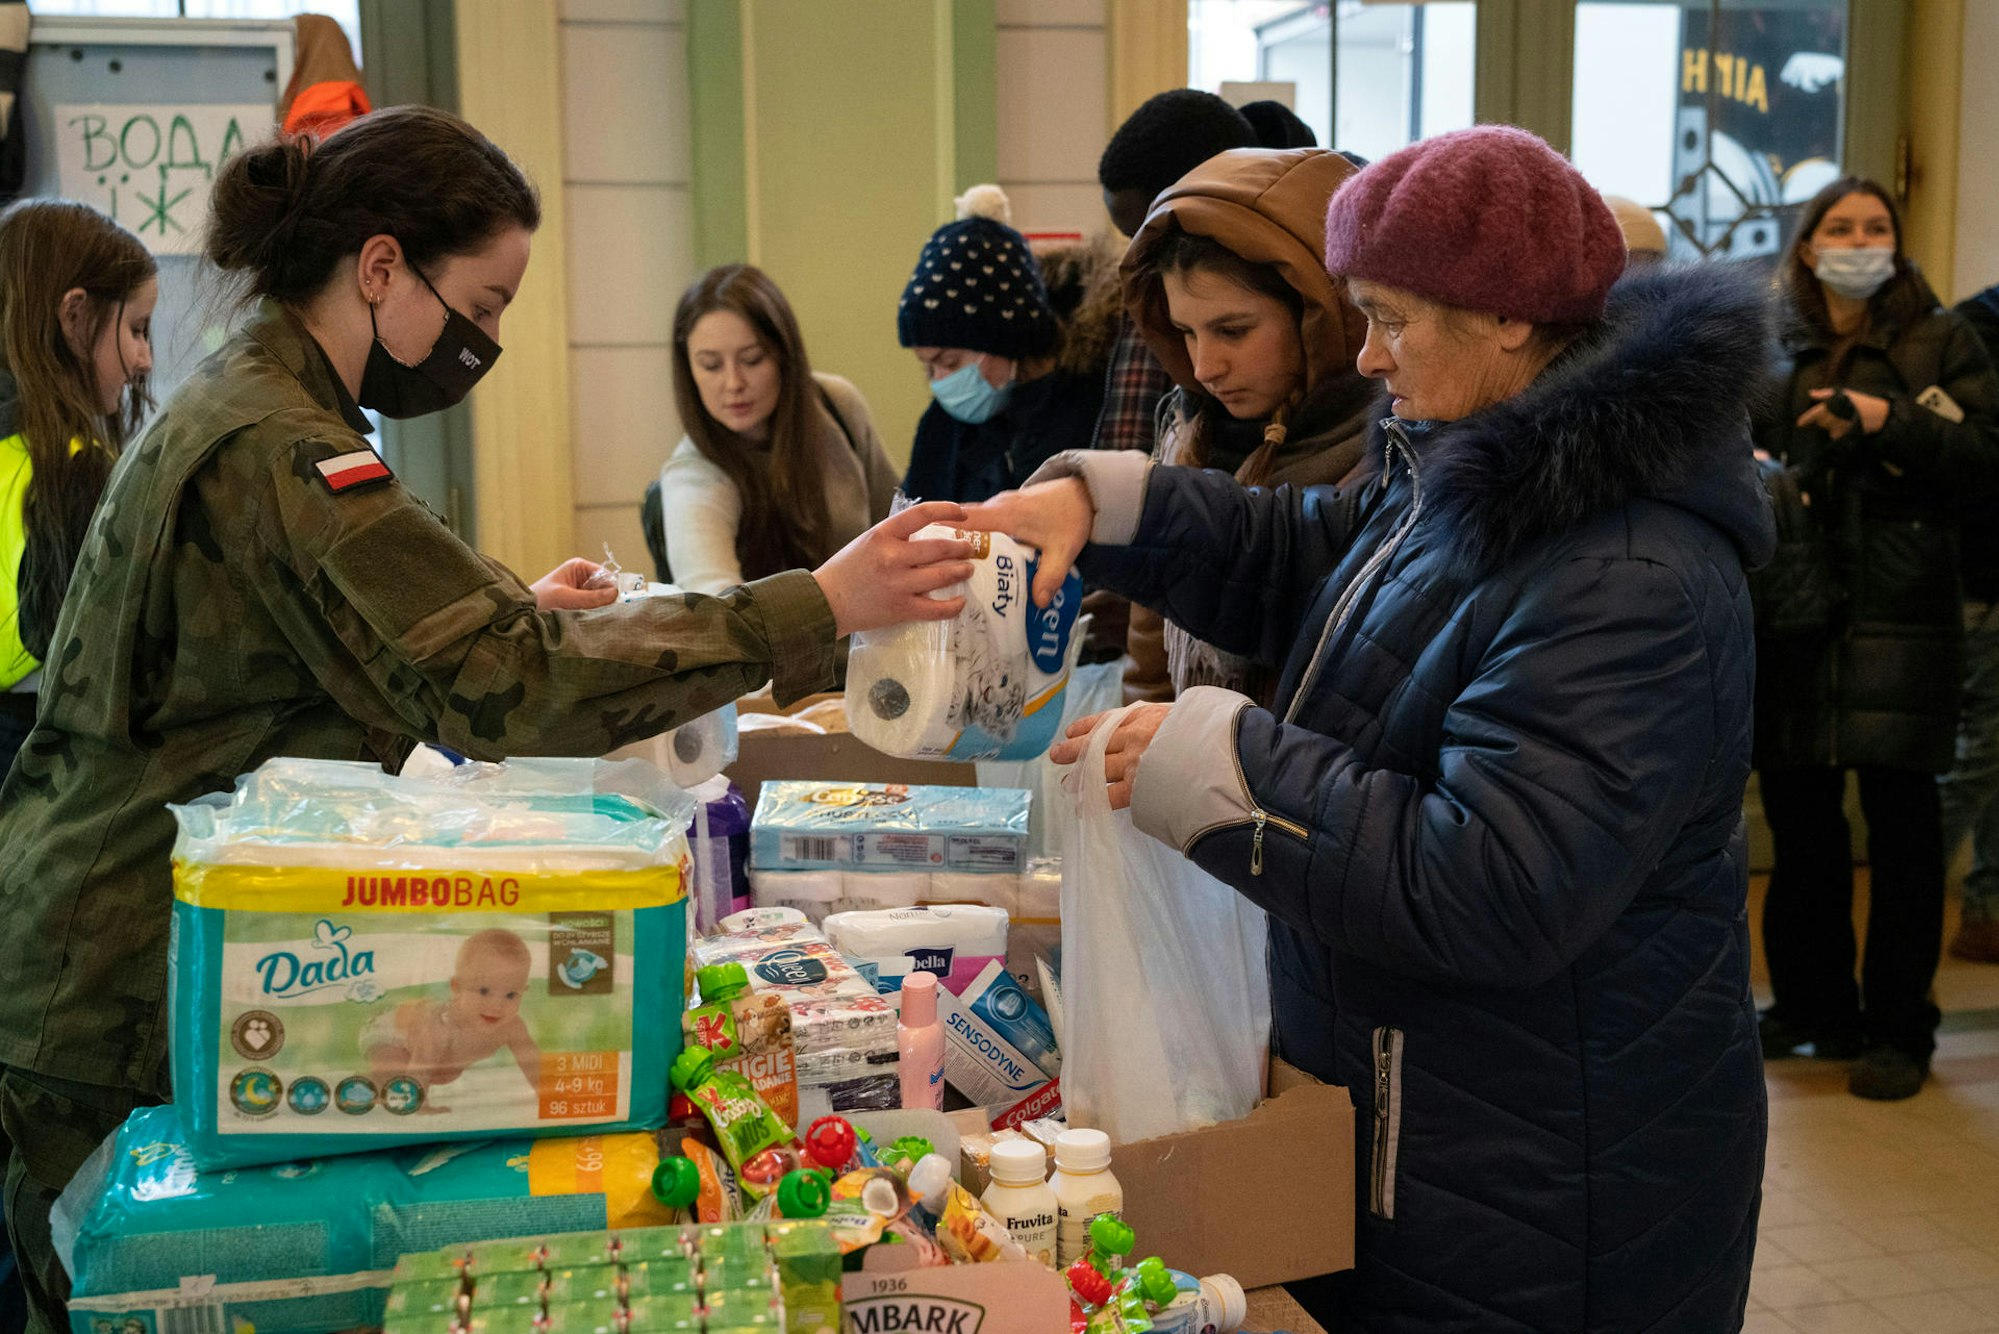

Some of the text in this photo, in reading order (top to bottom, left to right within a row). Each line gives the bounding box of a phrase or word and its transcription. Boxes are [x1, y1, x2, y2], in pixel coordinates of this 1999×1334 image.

[458, 347, 482, 370] WOT
[256, 941, 375, 994] Dada
[913, 954, 946, 971] bella
[946, 1012, 1026, 1082] SENSODYNE
[557, 1054, 603, 1072] 3 MIDI
[554, 1076, 604, 1095] 4-9 kg
[549, 1099, 607, 1115] 96 sztuk
[1006, 1214, 1054, 1231] Fruvita
[871, 1278, 908, 1293] 1936
